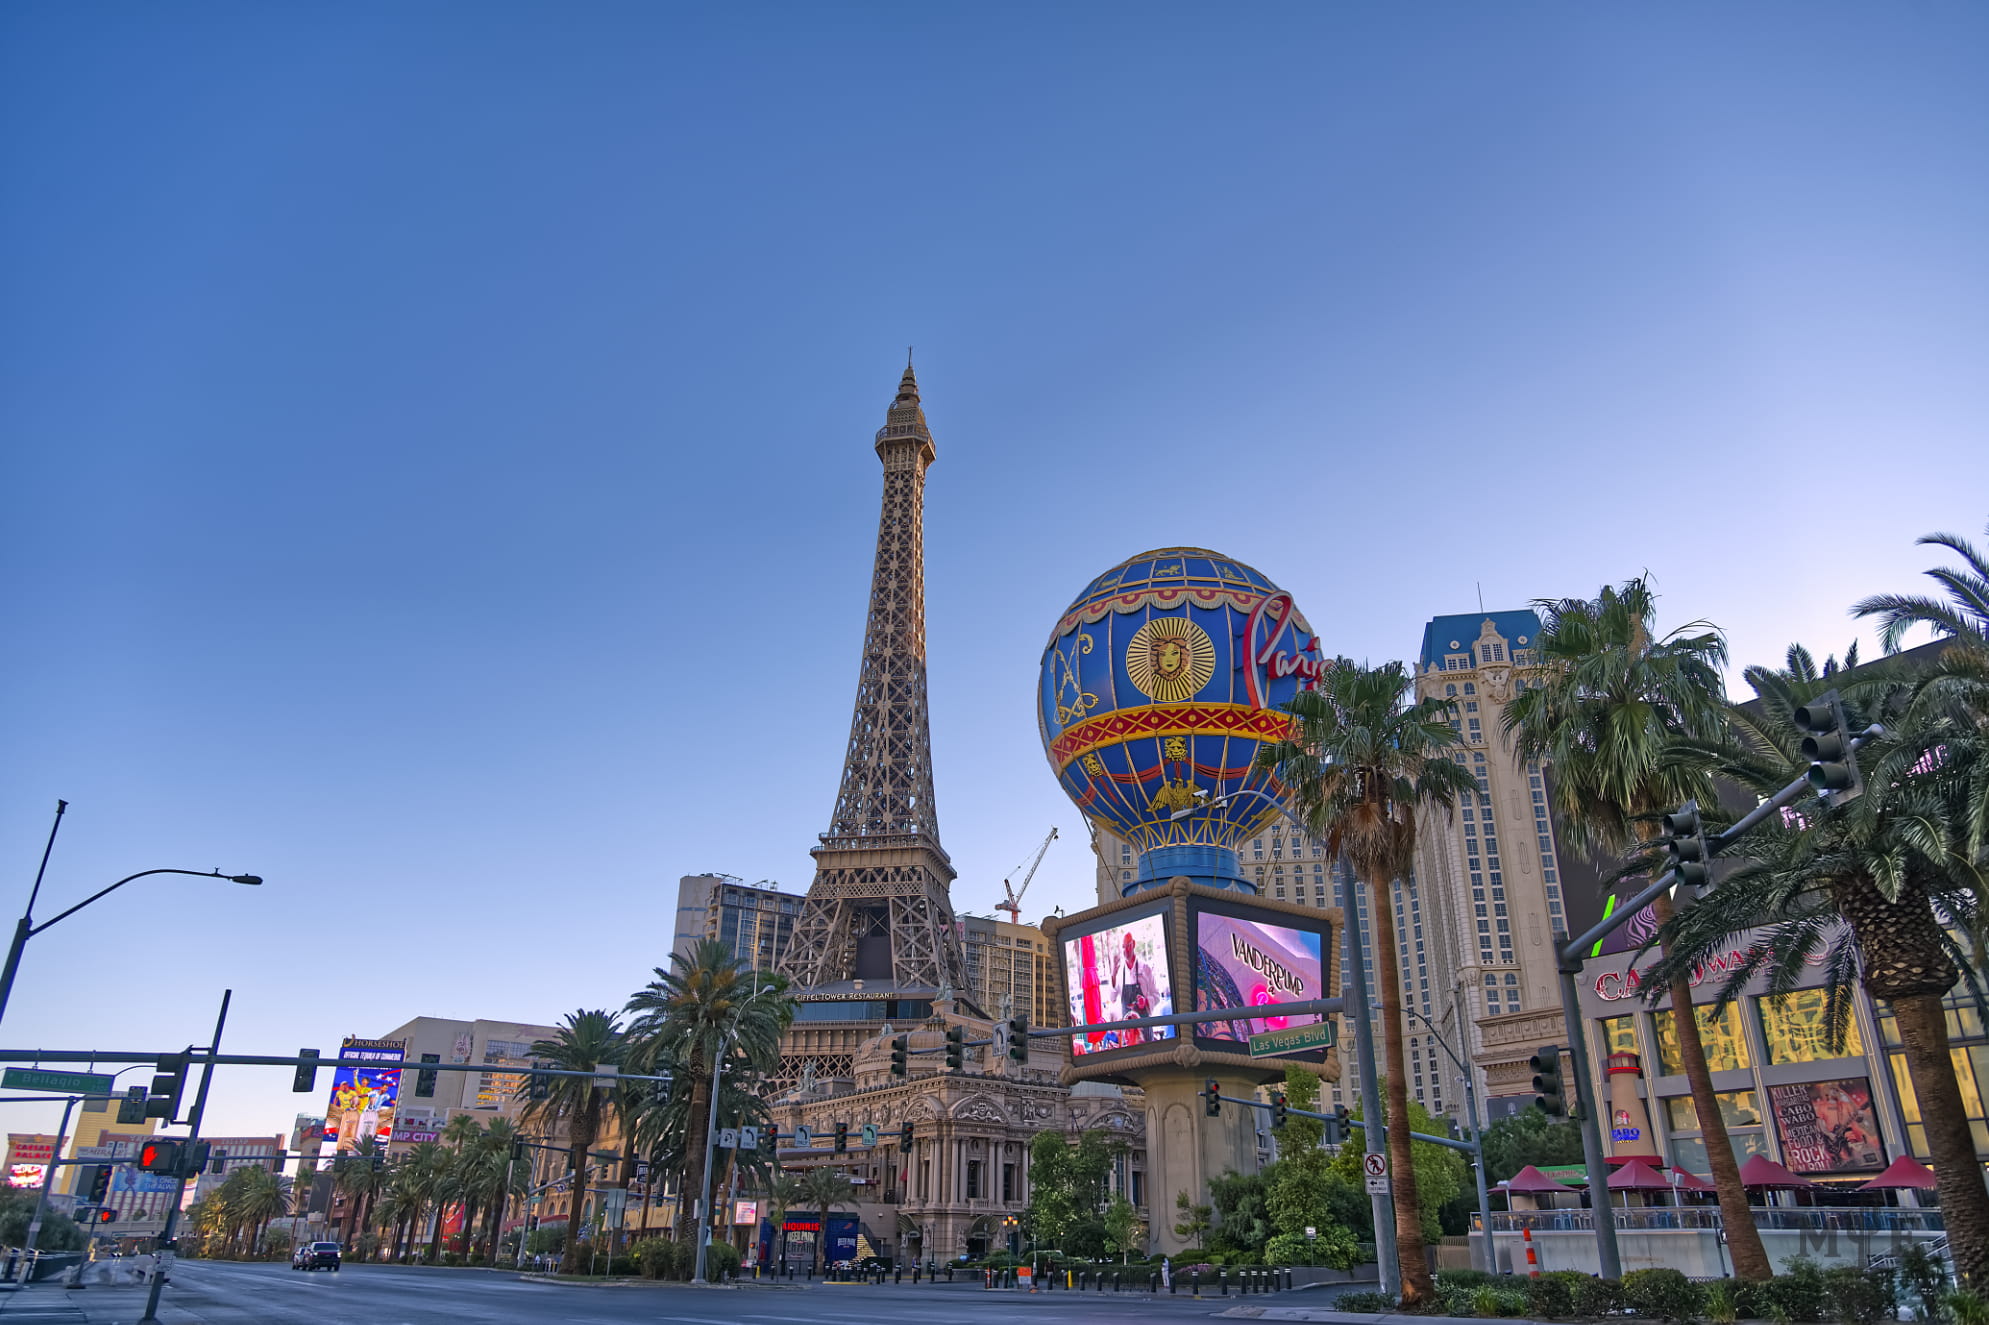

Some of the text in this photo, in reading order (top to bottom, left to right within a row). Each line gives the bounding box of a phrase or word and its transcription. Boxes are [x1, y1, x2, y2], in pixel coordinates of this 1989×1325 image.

[1231, 932, 1304, 998] VANDERPUMP
[848, 992, 894, 1000] RESTAURANT
[355, 1040, 405, 1048] HORSESHOE
[1253, 1028, 1327, 1052] Las Vegas Blvd
[22, 1073, 81, 1088] Bellagio
[1771, 1085, 1807, 1099] KILLER
[1779, 1103, 1812, 1117] CABO
[1780, 1112, 1815, 1126] WABO
[412, 1132, 437, 1142] CITY
[1785, 1124, 1820, 1139] MEXICAN
[1787, 1133, 1824, 1150] FOOD &
[15, 1151, 52, 1160] PALACE
[1790, 1145, 1830, 1163] ROCK
[782, 1222, 821, 1231] AIQUIRIS
